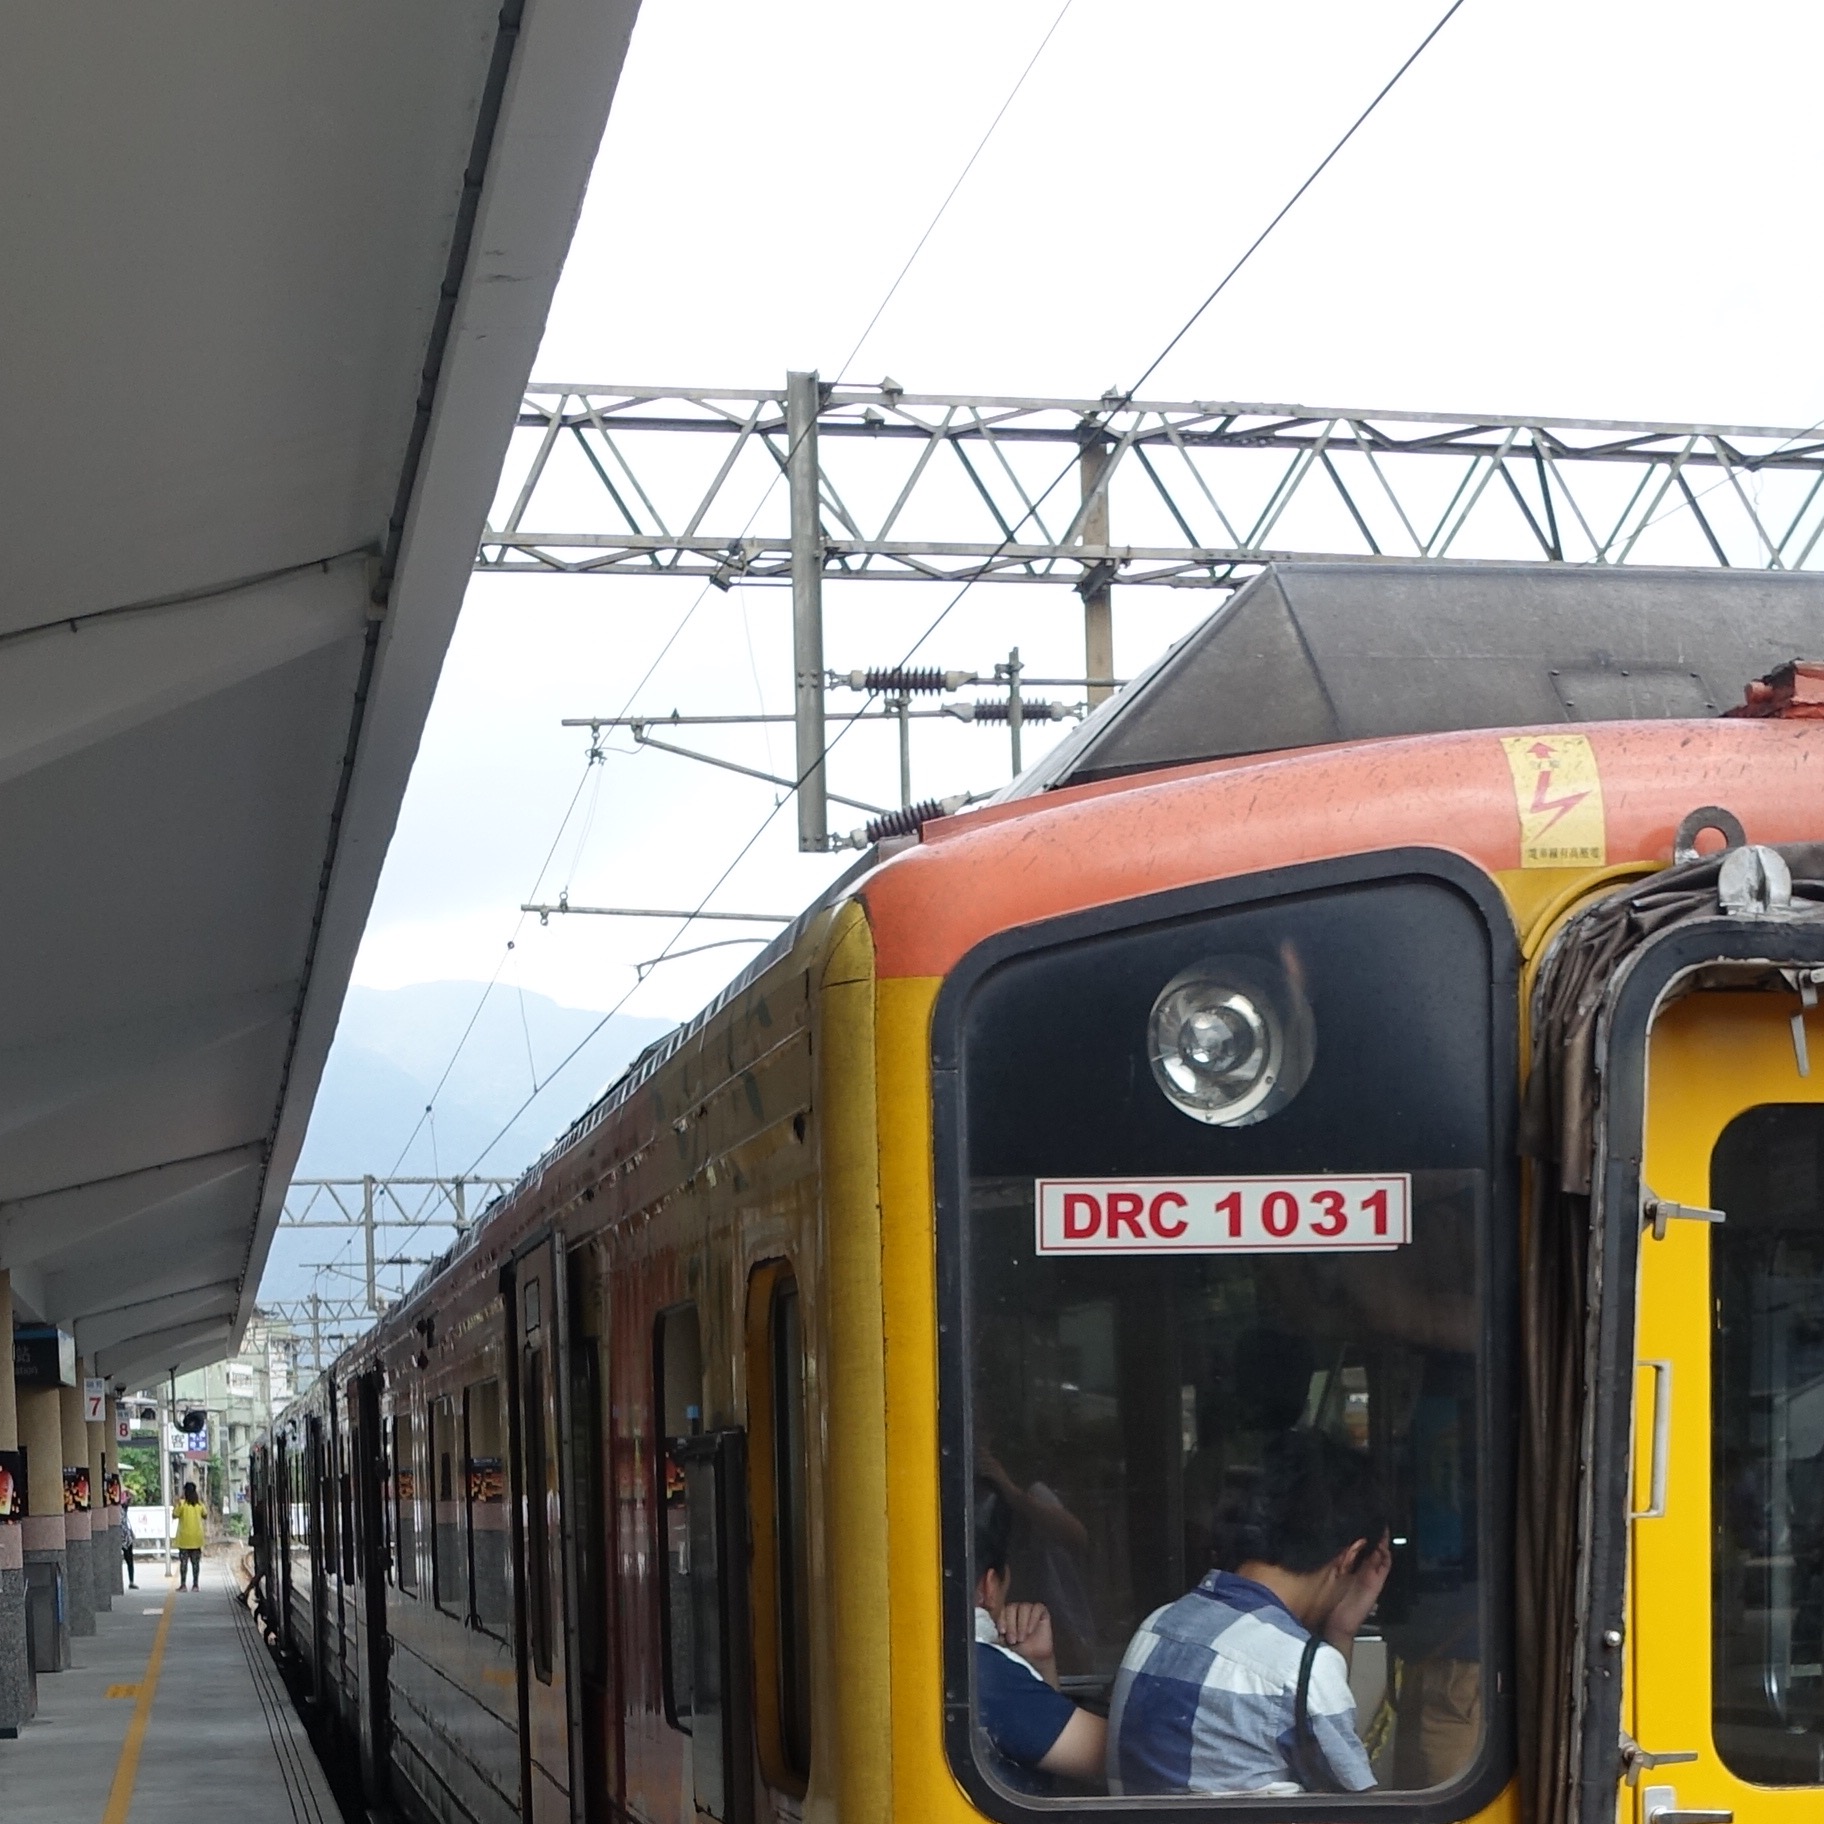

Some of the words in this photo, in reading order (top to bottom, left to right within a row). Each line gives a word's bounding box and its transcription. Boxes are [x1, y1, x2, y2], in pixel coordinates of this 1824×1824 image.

[1063, 1192, 1189, 1240] DRC
[1214, 1189, 1389, 1238] 1031
[89, 1397, 102, 1416] 7
[119, 1423, 129, 1438] 8
